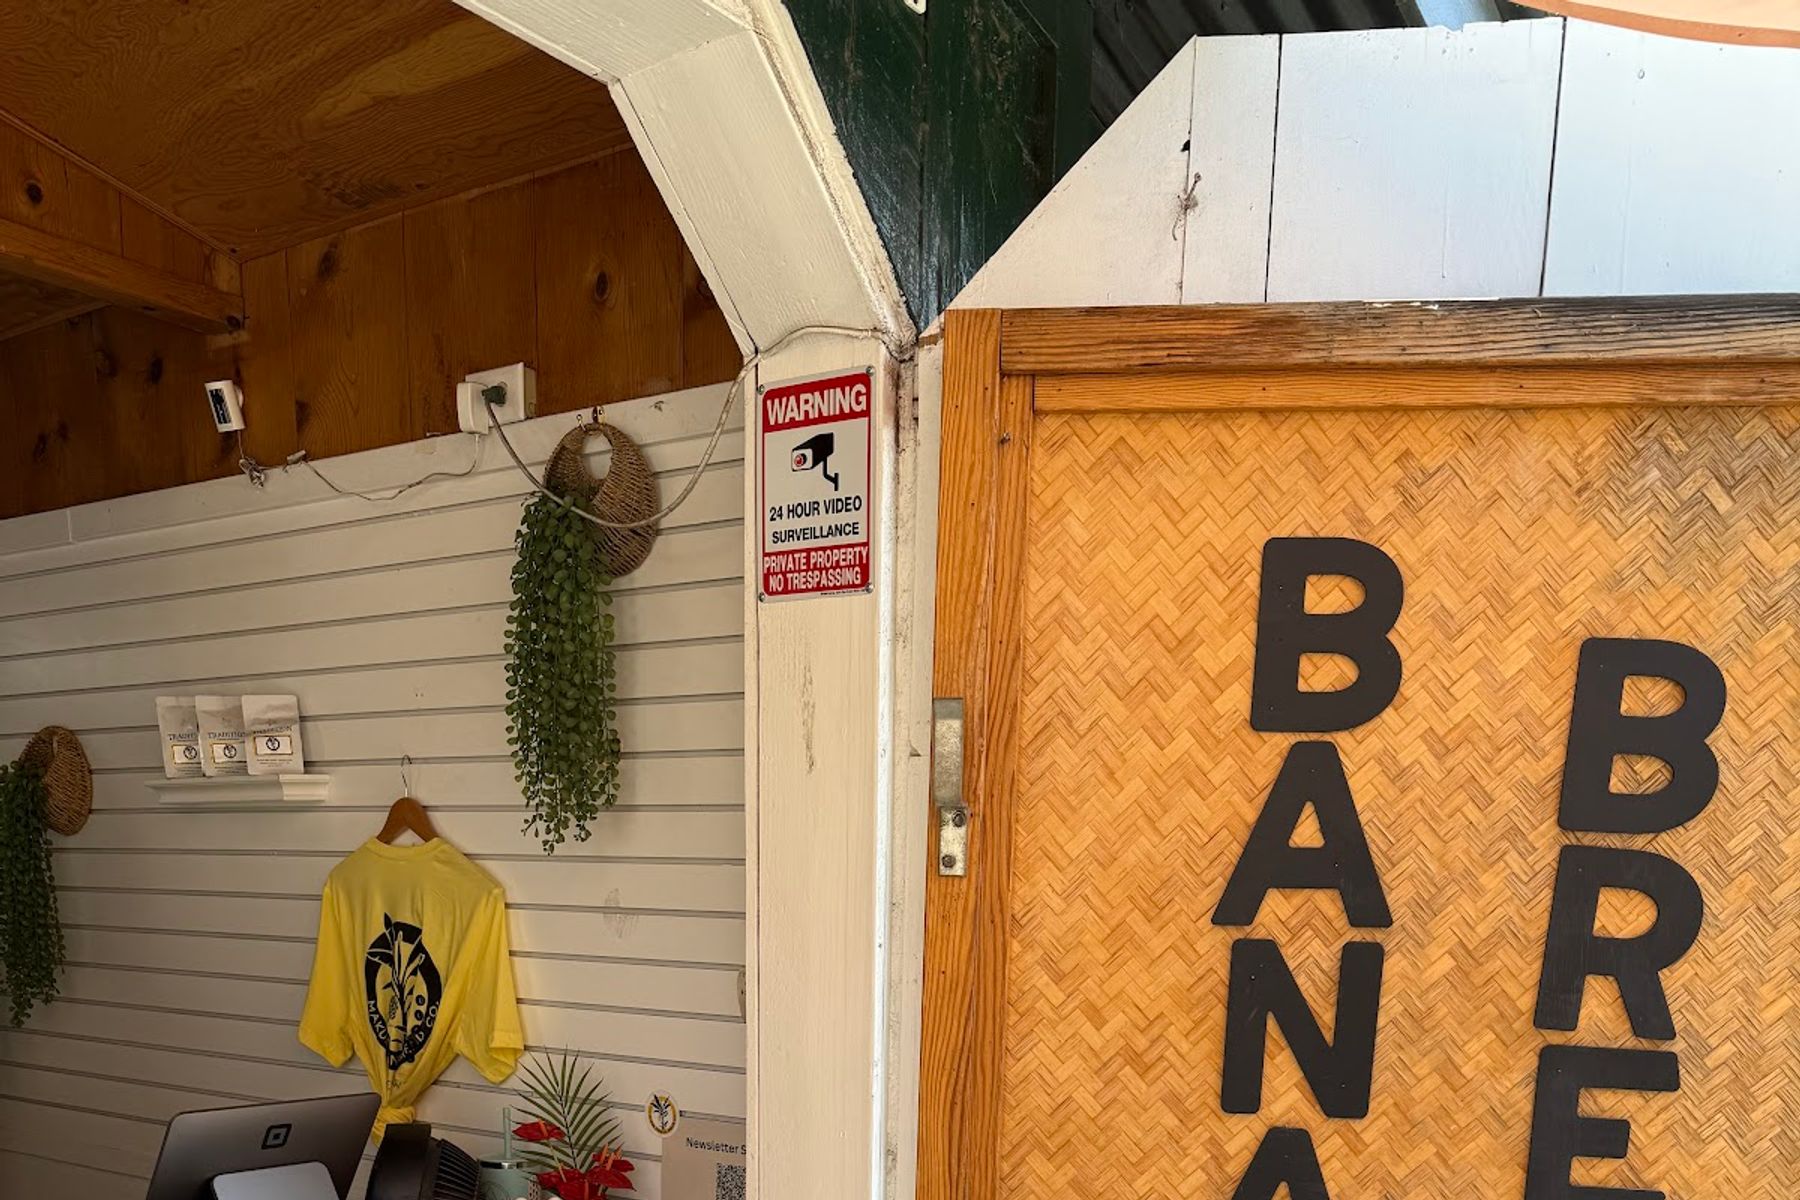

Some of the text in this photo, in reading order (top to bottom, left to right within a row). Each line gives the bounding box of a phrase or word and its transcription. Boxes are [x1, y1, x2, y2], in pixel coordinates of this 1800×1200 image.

[766, 383, 867, 426] WARNING
[769, 495, 862, 522] 24 HOUR VIDEO
[772, 522, 860, 544] SURVEILLANCE
[764, 546, 868, 574] PRIVATE PROPERTY
[769, 567, 861, 592] NO TRESPASSING
[685, 1137, 739, 1154] Newsletter
